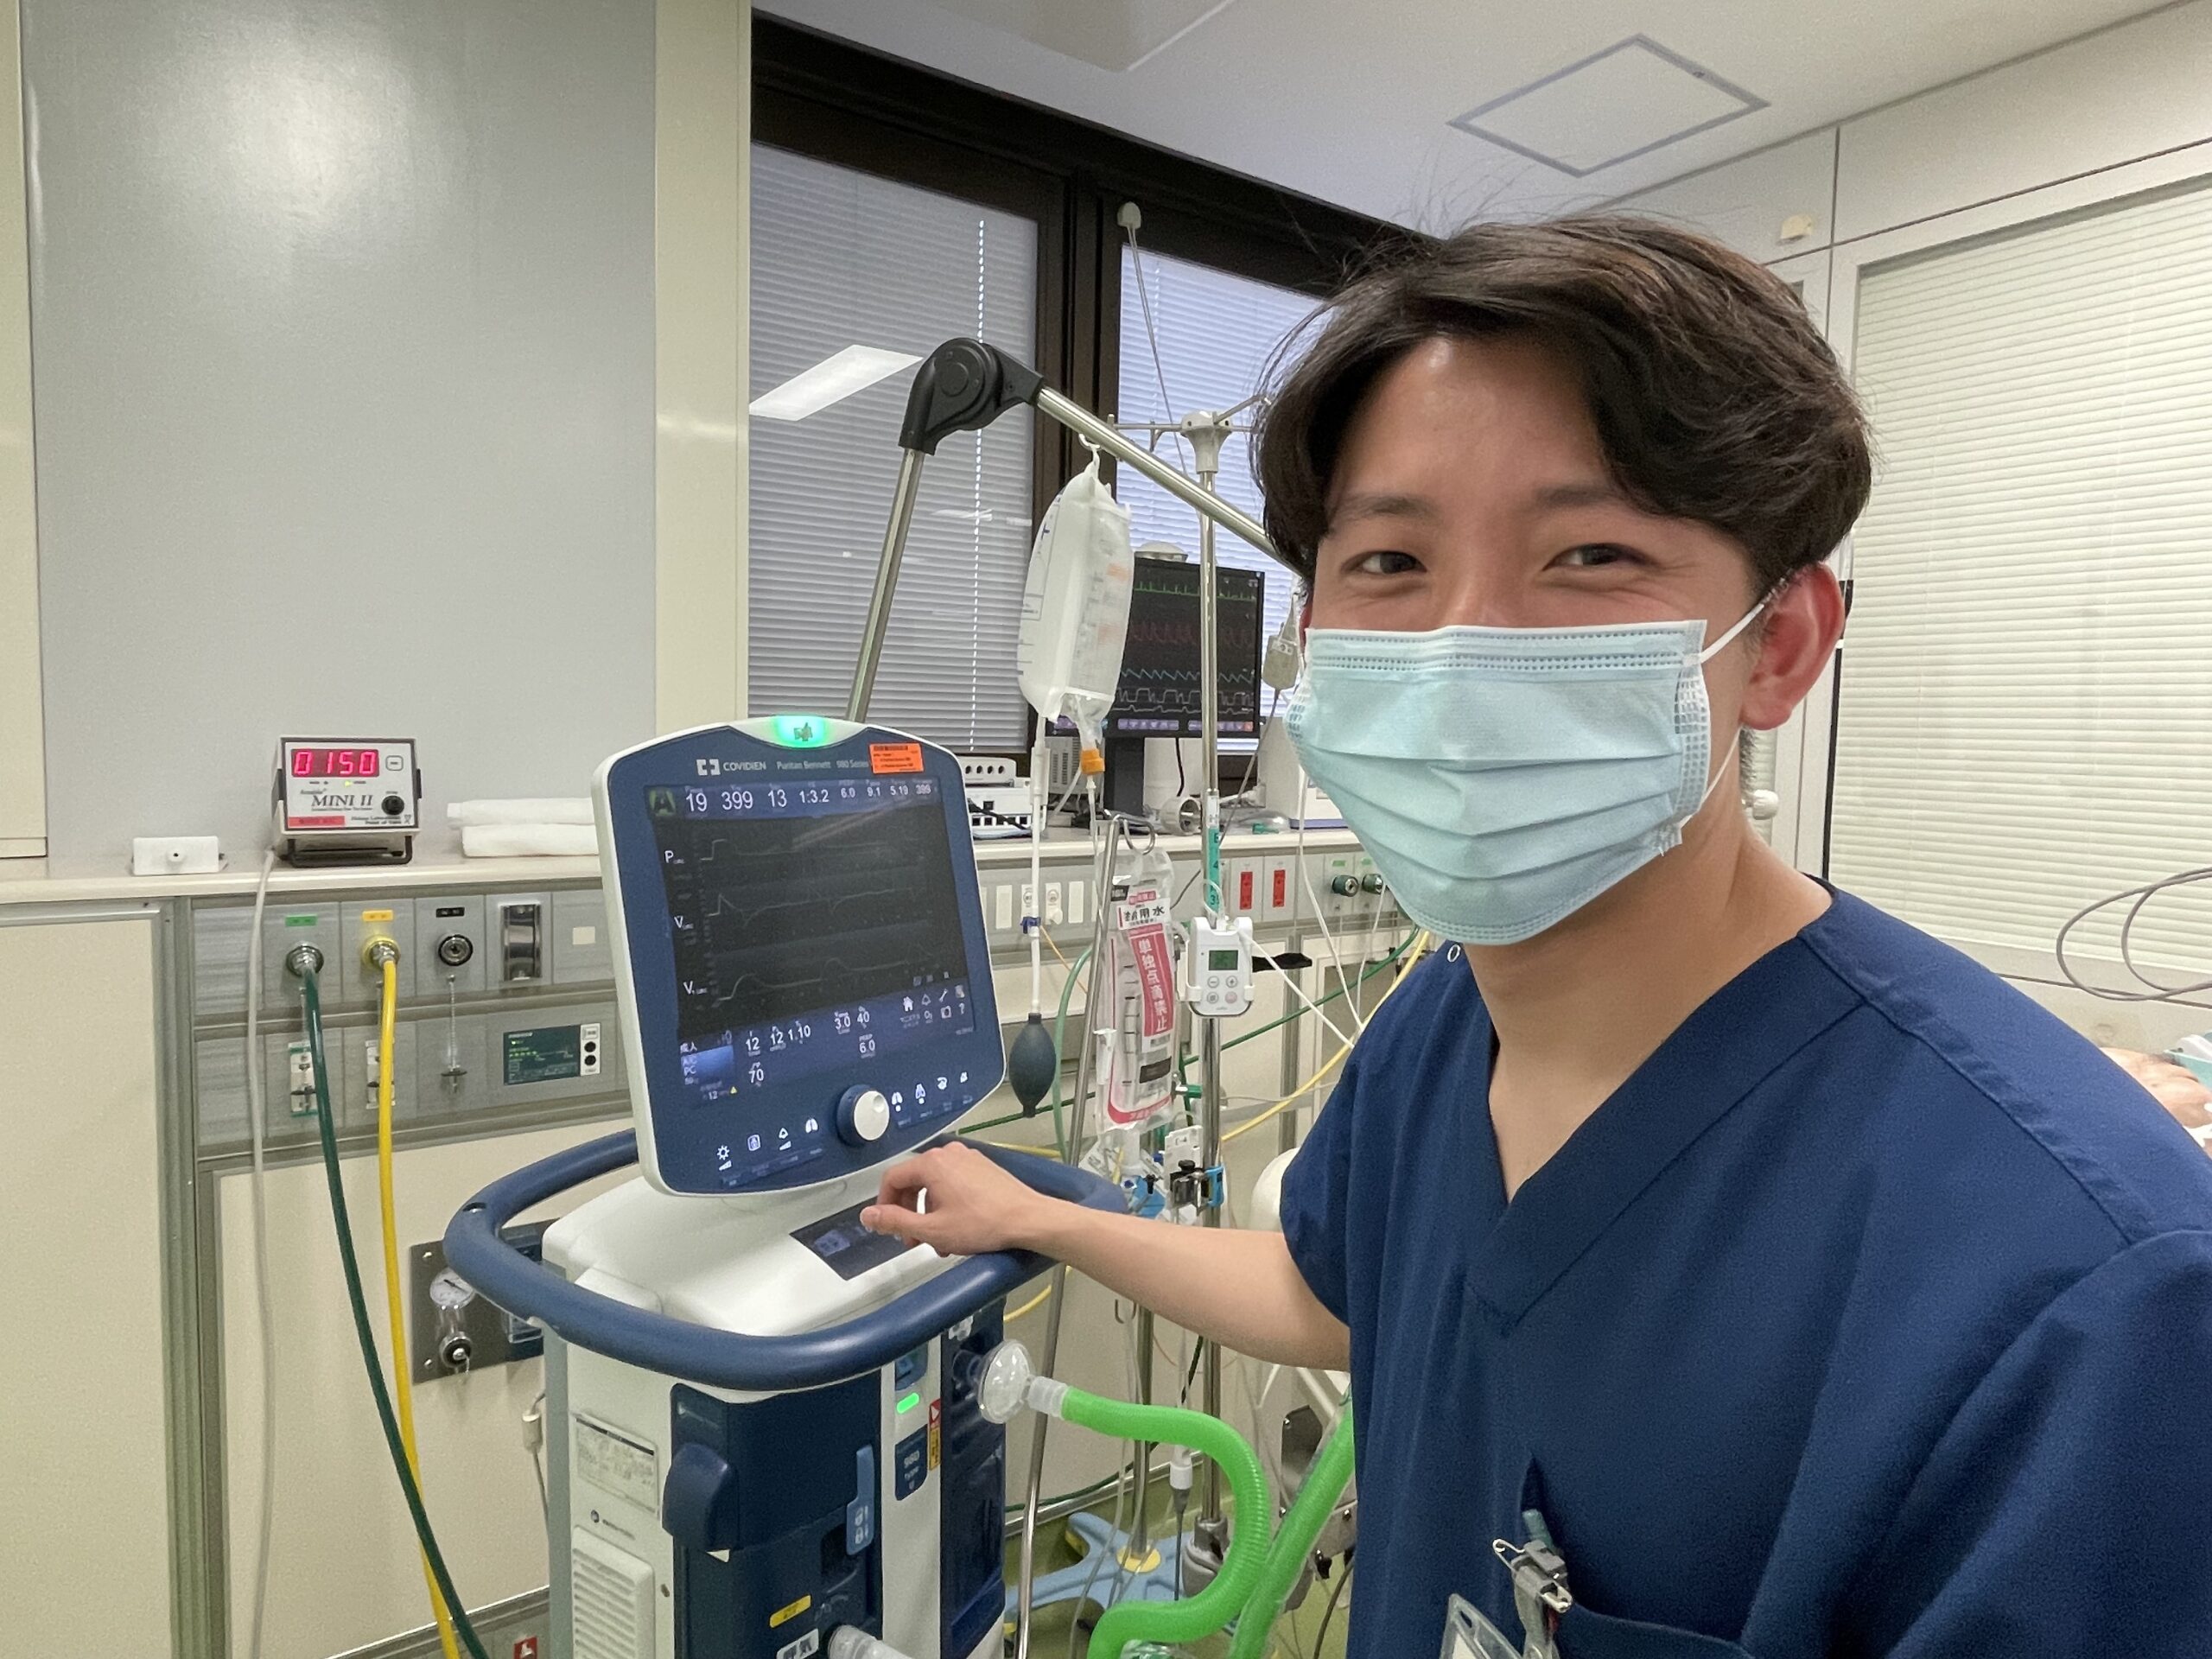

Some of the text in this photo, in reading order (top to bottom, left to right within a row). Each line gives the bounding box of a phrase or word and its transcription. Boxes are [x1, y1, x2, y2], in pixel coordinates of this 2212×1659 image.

[722, 761, 766, 771] COVIDIEN
[311, 794, 373, 807] MINI II
[685, 792, 708, 812] 19
[721, 791, 753, 810] 399
[767, 789, 787, 808] 13
[857, 1010, 870, 1024] 40
[746, 1037, 760, 1052] 12
[770, 1031, 784, 1046] 12
[748, 1068, 764, 1084] 70
